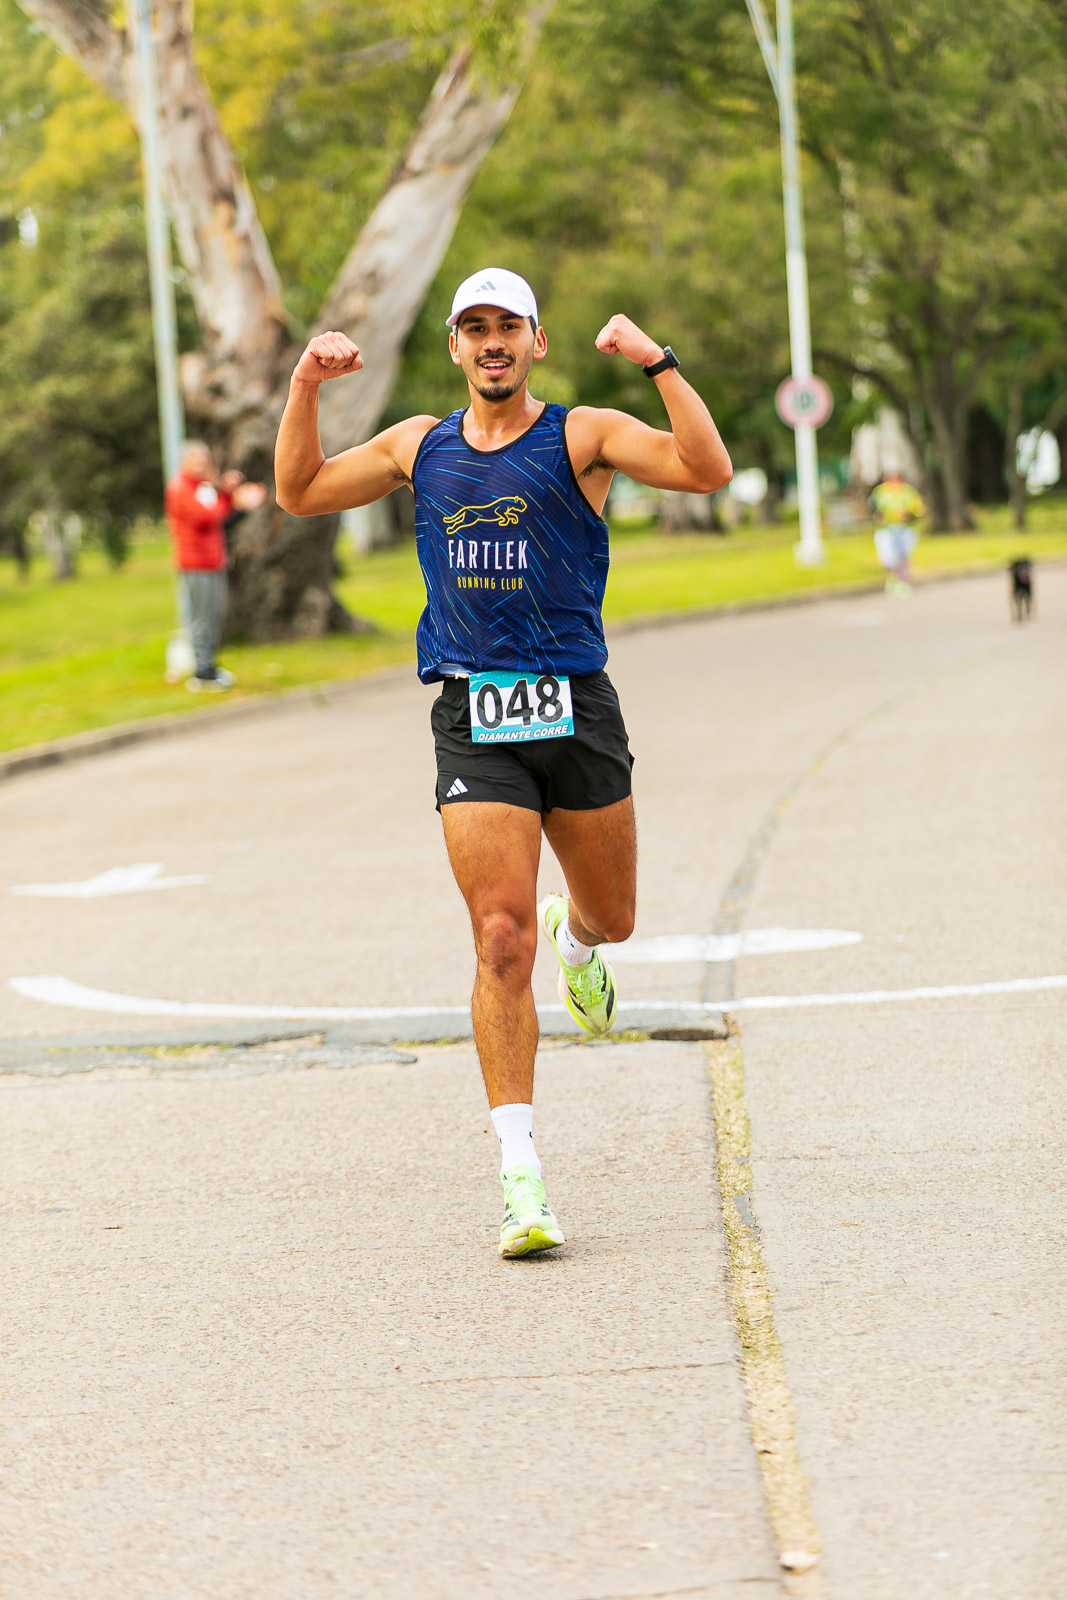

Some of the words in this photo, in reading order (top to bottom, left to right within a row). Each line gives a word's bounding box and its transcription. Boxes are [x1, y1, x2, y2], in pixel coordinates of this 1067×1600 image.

[448, 539, 528, 570] FARTLEK
[457, 576, 496, 590] RUNNING
[501, 577, 523, 590] CLUB
[476, 675, 563, 730] 048
[477, 730, 532, 741] DIAMANTE
[533, 725, 569, 737] CORRE
